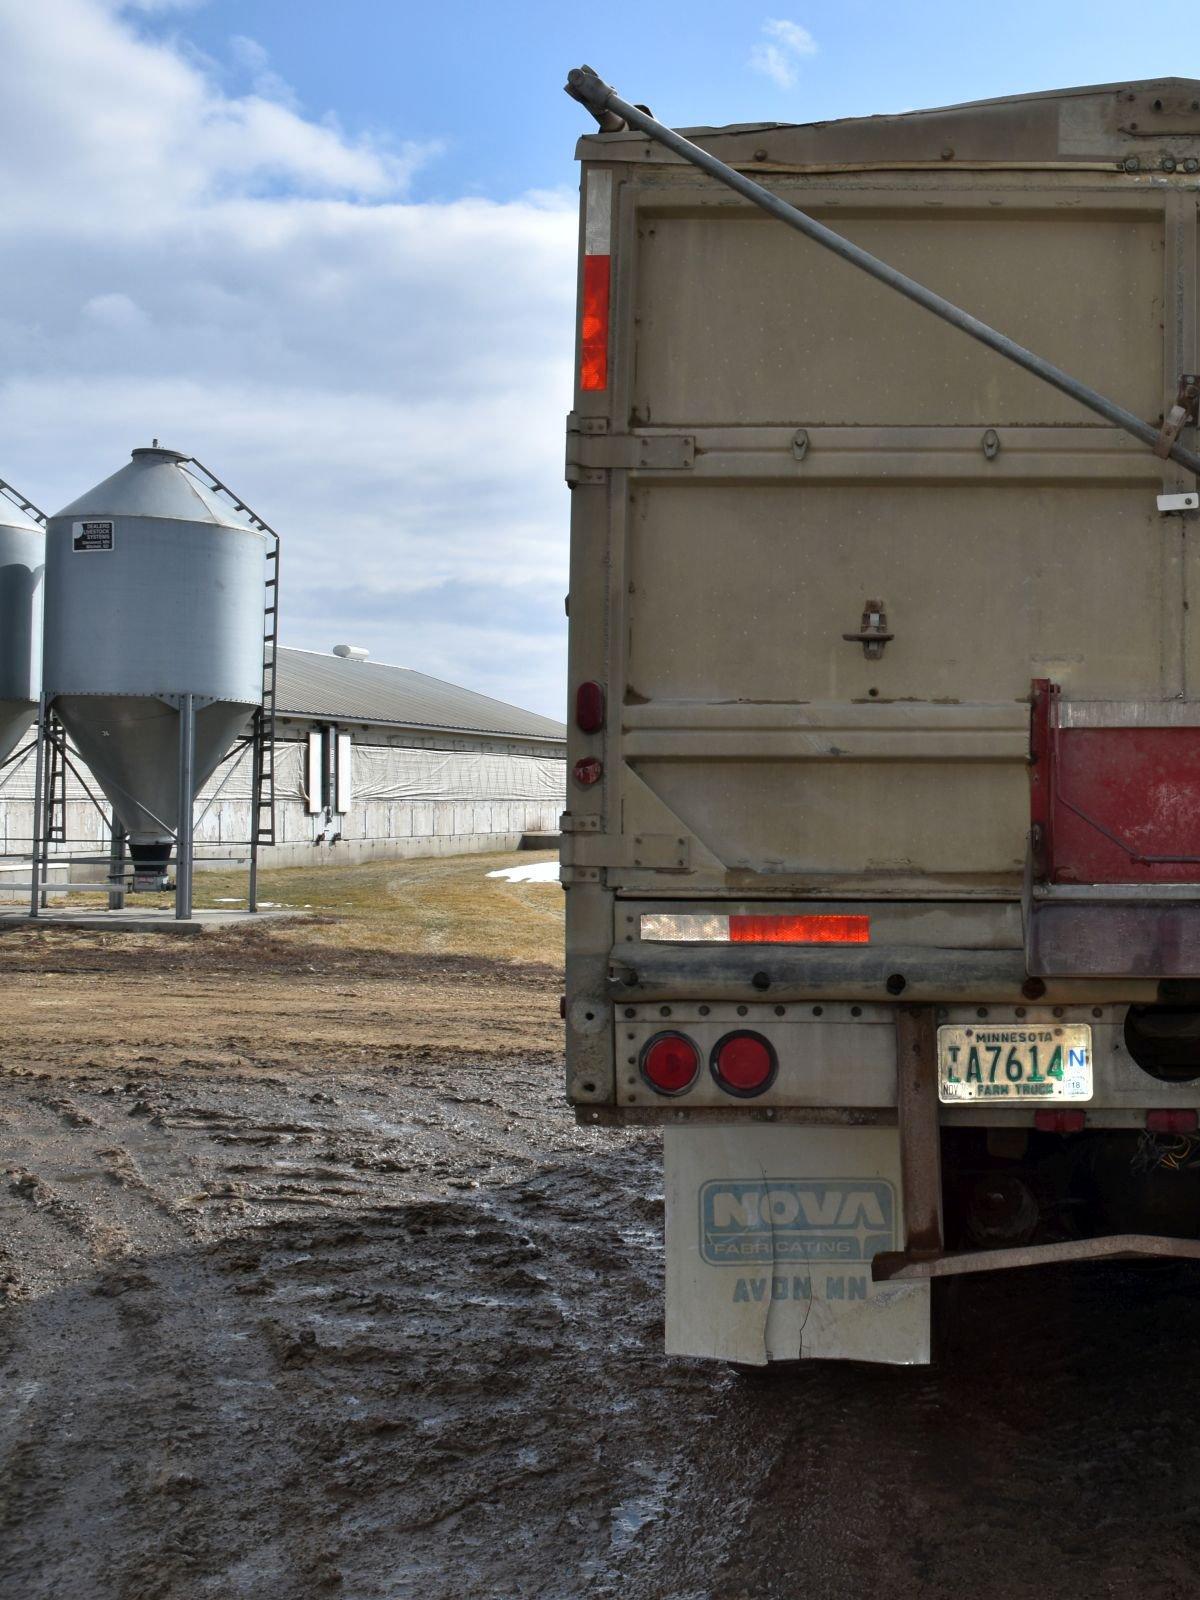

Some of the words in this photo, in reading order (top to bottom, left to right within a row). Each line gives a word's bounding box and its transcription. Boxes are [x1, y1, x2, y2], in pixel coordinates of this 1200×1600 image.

[976, 1032, 1053, 1043] MINNESOTA
[966, 1045, 1064, 1083] A7614
[1069, 1049, 1084, 1067] N
[977, 1084, 1009, 1096] FARM
[1015, 1083, 1054, 1095] TRUCK
[1071, 1081, 1081, 1089] 18
[713, 1190, 886, 1227] NOVA
[713, 1240, 851, 1255] FABRICATING
[732, 1276, 812, 1303] AVON
[826, 1275, 868, 1301] MN
